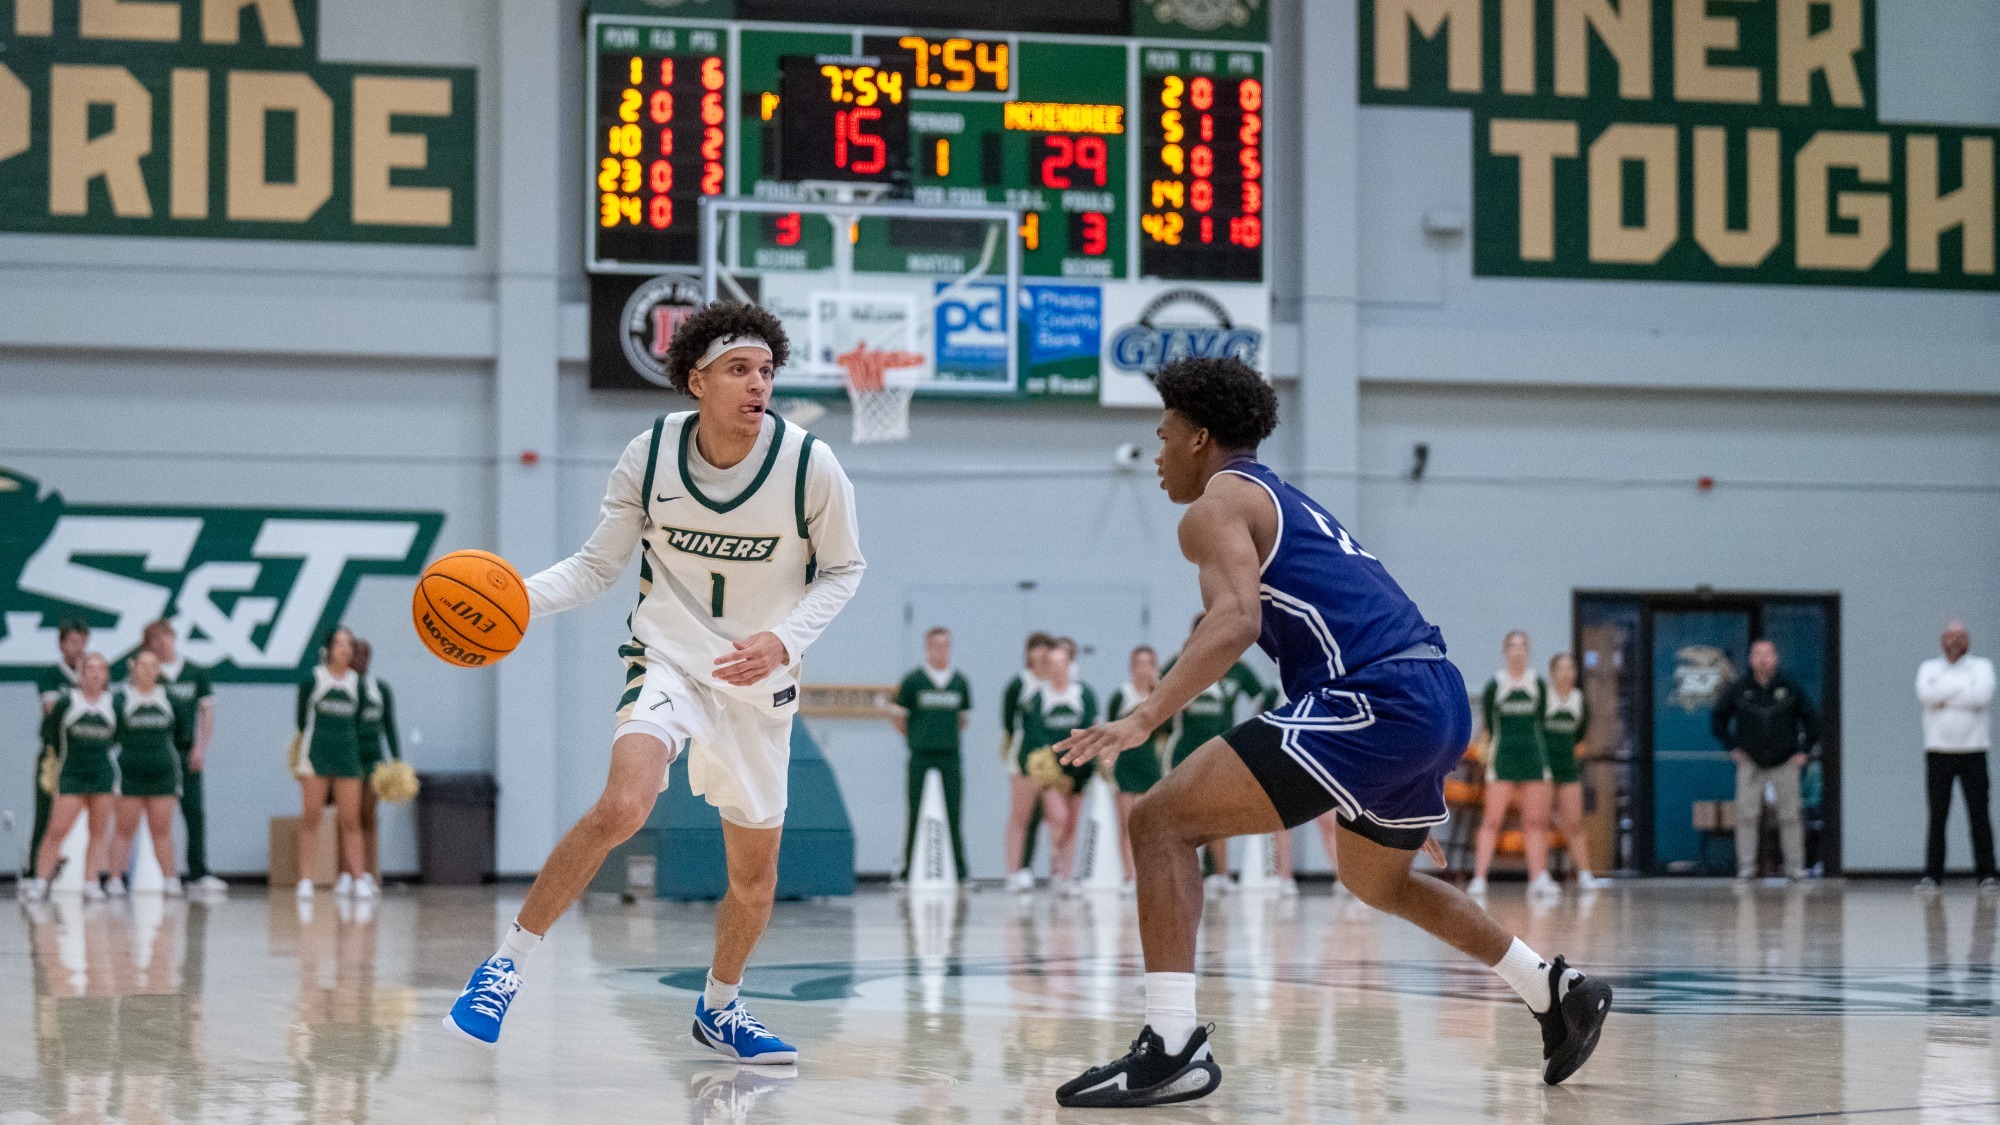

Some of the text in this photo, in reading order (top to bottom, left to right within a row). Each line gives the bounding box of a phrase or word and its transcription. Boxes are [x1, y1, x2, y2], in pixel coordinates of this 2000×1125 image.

[630, 56, 725, 90] 1 1 6
[899, 36, 1009, 92] 7:54
[1374, 0, 1865, 108] MINER
[820, 65, 902, 107] 7:54
[1161, 75, 1262, 112] 2 0 0
[619, 88, 643, 123] 2
[650, 89, 674, 124] 0
[702, 91, 725, 126] 6
[609, 123, 725, 161] 10 1 2
[834, 107, 887, 175] 15
[1161, 109, 1262, 146] 5 1 2
[598, 157, 725, 196] 23 0 2
[936, 138, 949, 177] 1
[1041, 135, 1107, 189] 29
[1190, 144, 1213, 179] 0
[1239, 146, 1262, 180] 5
[601, 192, 673, 229] 34 0
[1190, 178, 1213, 213] 0
[1241, 180, 1262, 215] 3
[1489, 118, 1996, 275] TOUGH
[1082, 212, 1107, 255] 3
[1141, 211, 1262, 249] 42 1 10
[671, 530, 774, 558] MINERS
[0, 515, 421, 669] S&T
[710, 571, 726, 618] 1
[421, 611, 487, 666] Wilson
